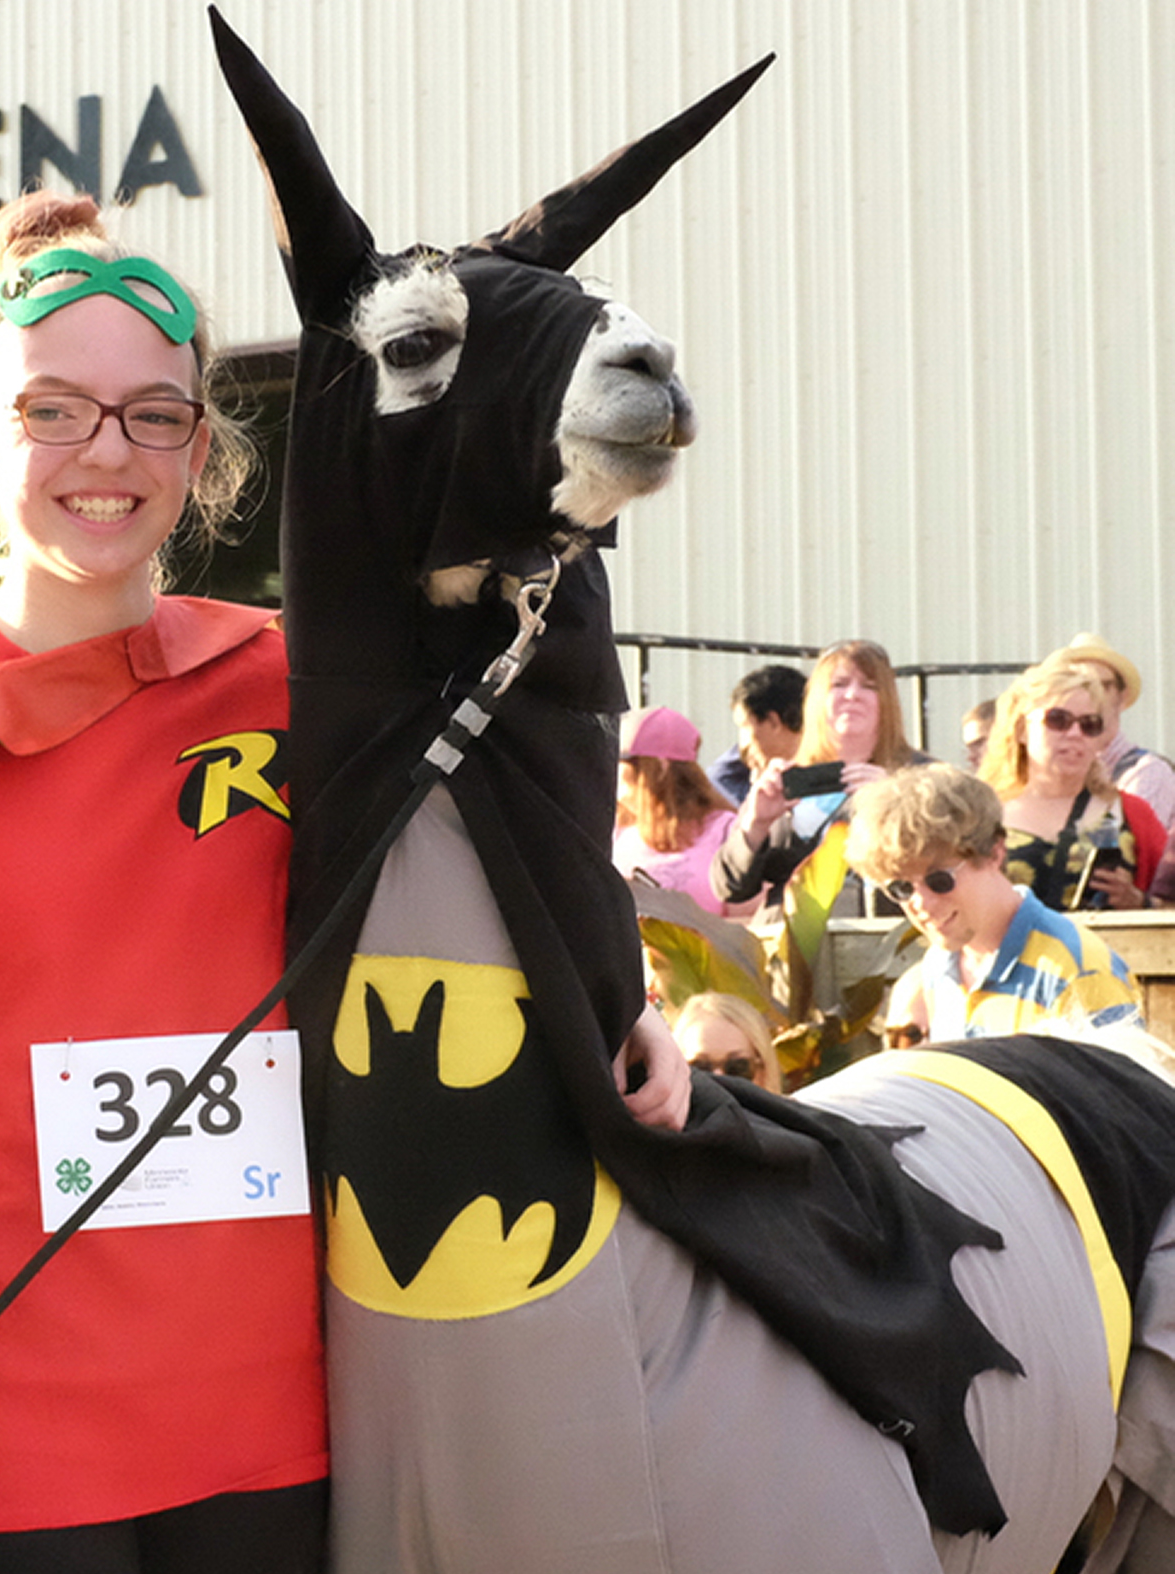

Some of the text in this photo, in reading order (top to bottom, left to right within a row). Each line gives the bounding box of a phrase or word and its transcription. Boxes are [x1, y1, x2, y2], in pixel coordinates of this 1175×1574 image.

[177, 730, 292, 838] R
[92, 1064, 243, 1144] 328
[243, 1164, 282, 1200] Sr
